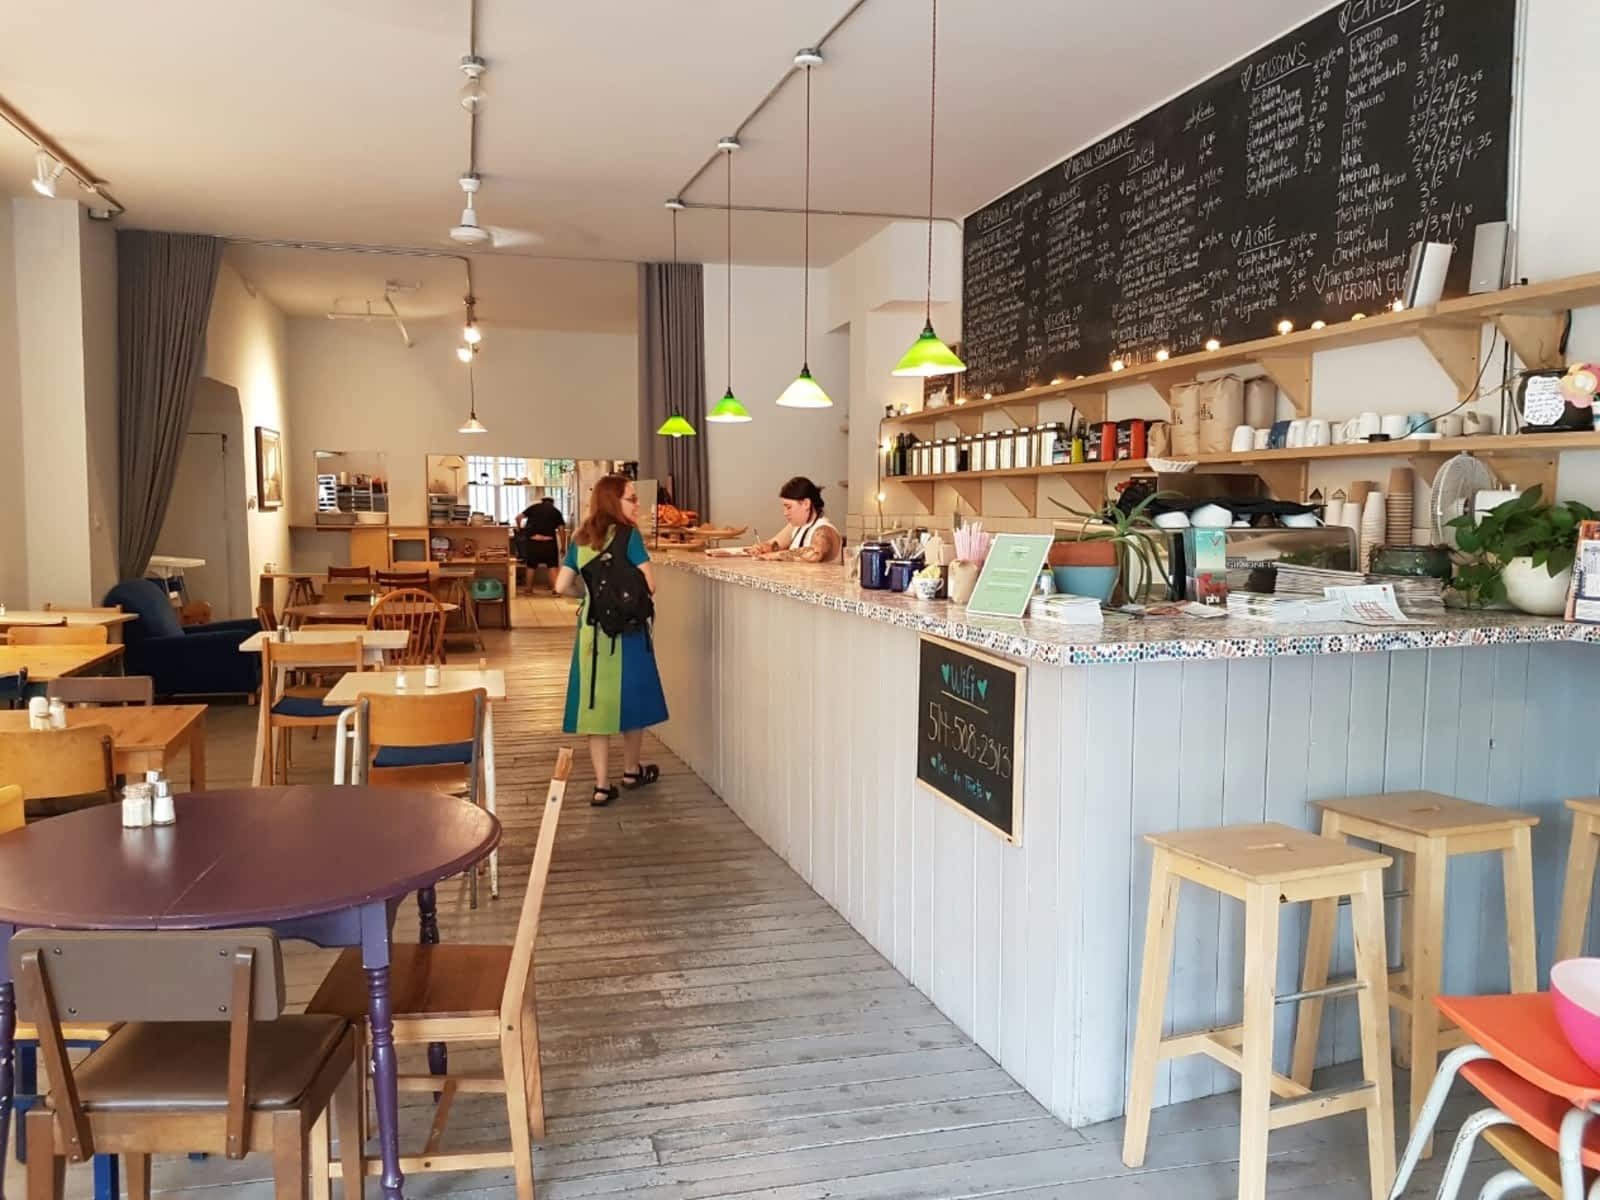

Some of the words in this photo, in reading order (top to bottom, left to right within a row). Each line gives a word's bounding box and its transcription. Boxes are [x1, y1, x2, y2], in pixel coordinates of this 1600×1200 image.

[1255, 41, 1307, 85] BOISSONS
[1342, 117, 1365, 137] Filtre
[1127, 141, 1155, 172] LUNCH
[1339, 163, 1379, 182] Americano
[1337, 277, 1381, 303] VERSION
[1206, 594, 1220, 606] phi
[950, 665, 976, 702] Wifi
